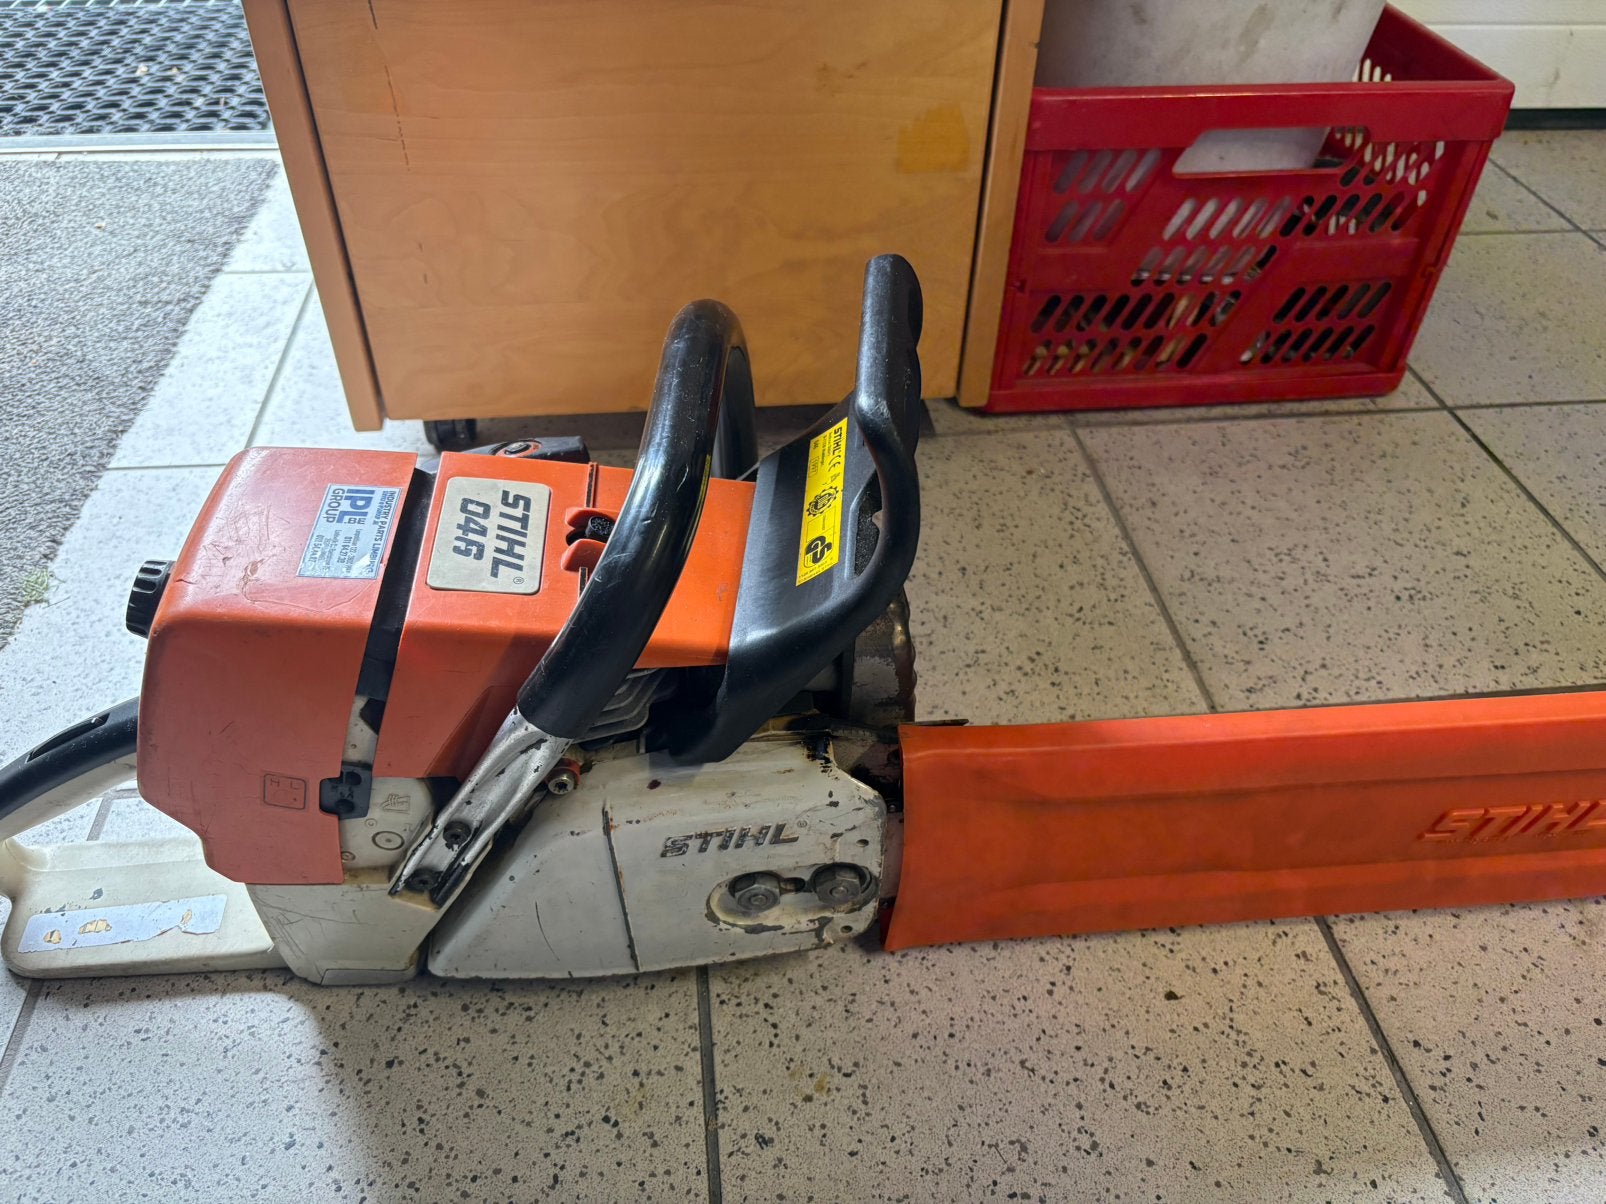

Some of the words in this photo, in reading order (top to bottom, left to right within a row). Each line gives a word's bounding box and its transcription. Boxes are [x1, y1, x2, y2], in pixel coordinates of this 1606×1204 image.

[832, 426, 843, 456] STIHL
[323, 488, 345, 523] GROUP
[336, 489, 376, 524] IPL
[382, 491, 396, 519] INDUSTRY
[375, 519, 387, 542] PARTS
[453, 498, 491, 561] 046
[490, 490, 532, 579] STIHL
[660, 823, 800, 858] STIHL
